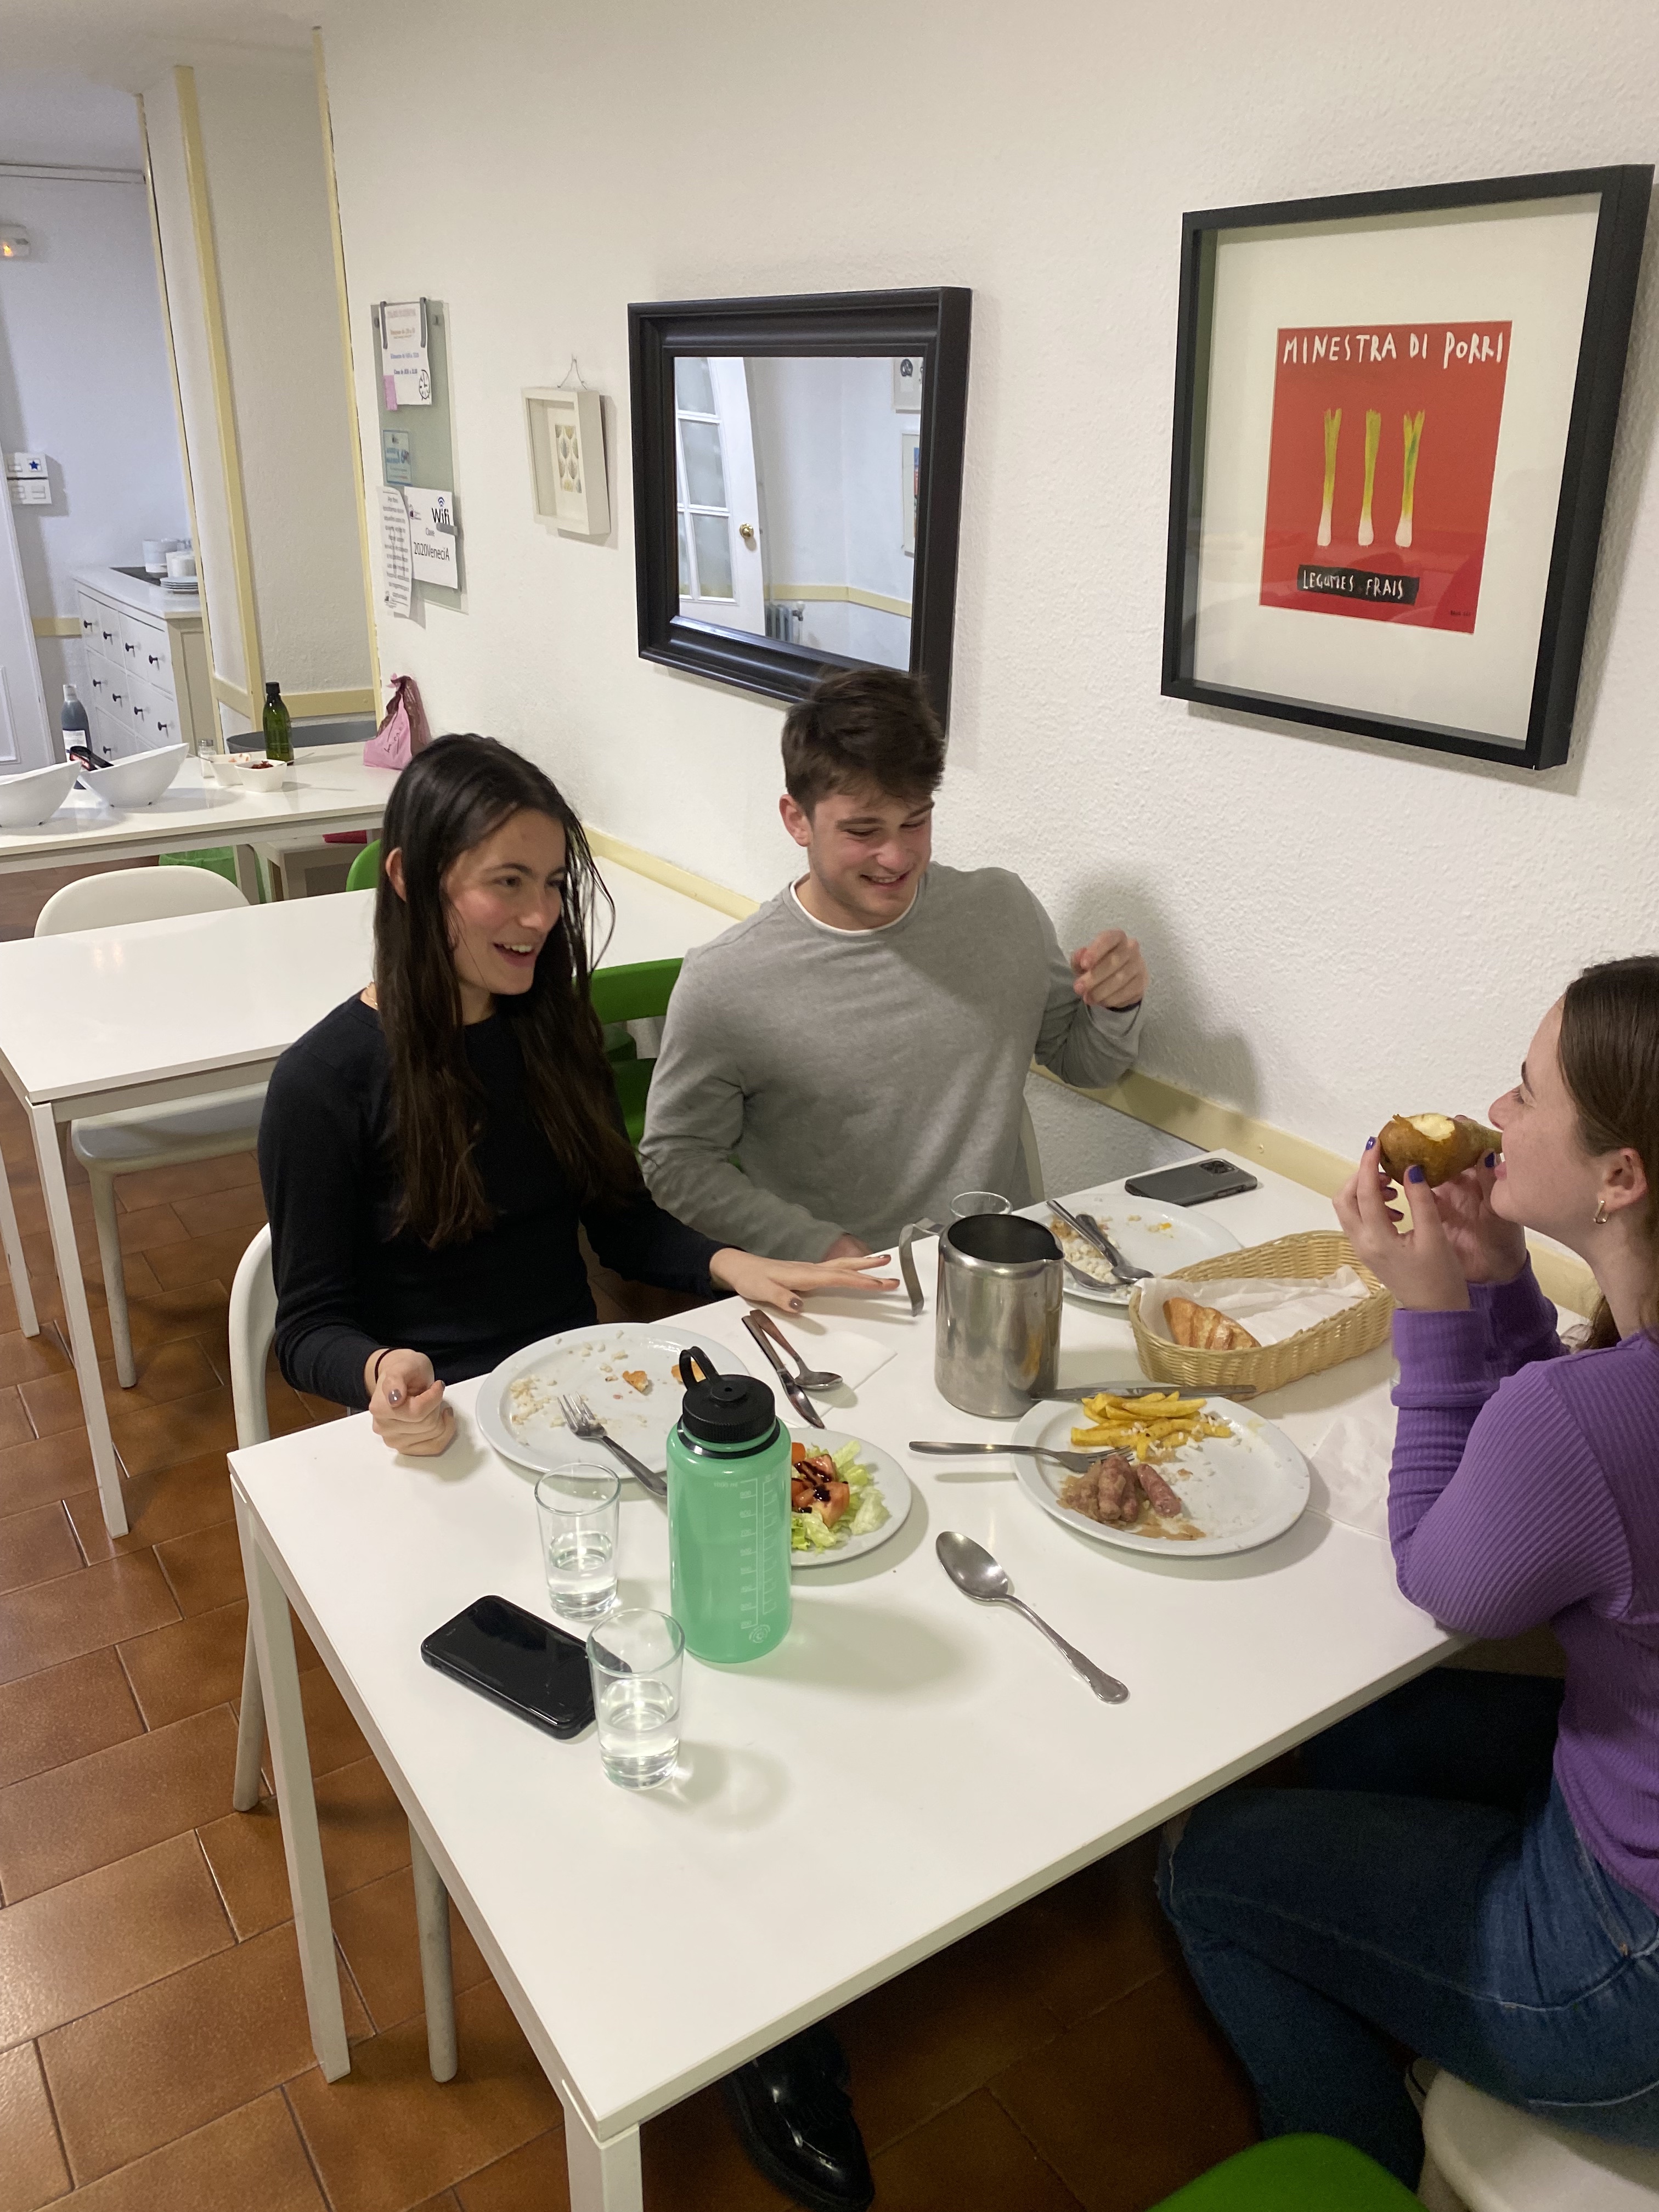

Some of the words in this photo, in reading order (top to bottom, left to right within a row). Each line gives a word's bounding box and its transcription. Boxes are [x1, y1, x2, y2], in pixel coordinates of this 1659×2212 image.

[1283, 332, 1397, 364] MINESTRA
[1409, 332, 1428, 359] DI
[1443, 331, 1503, 369] PORRI
[431, 507, 450, 525] Wifi
[413, 541, 450, 561] 2020VeneciA
[1302, 569, 1355, 592] LEGUMES
[1365, 576, 1404, 599] FRAIS
